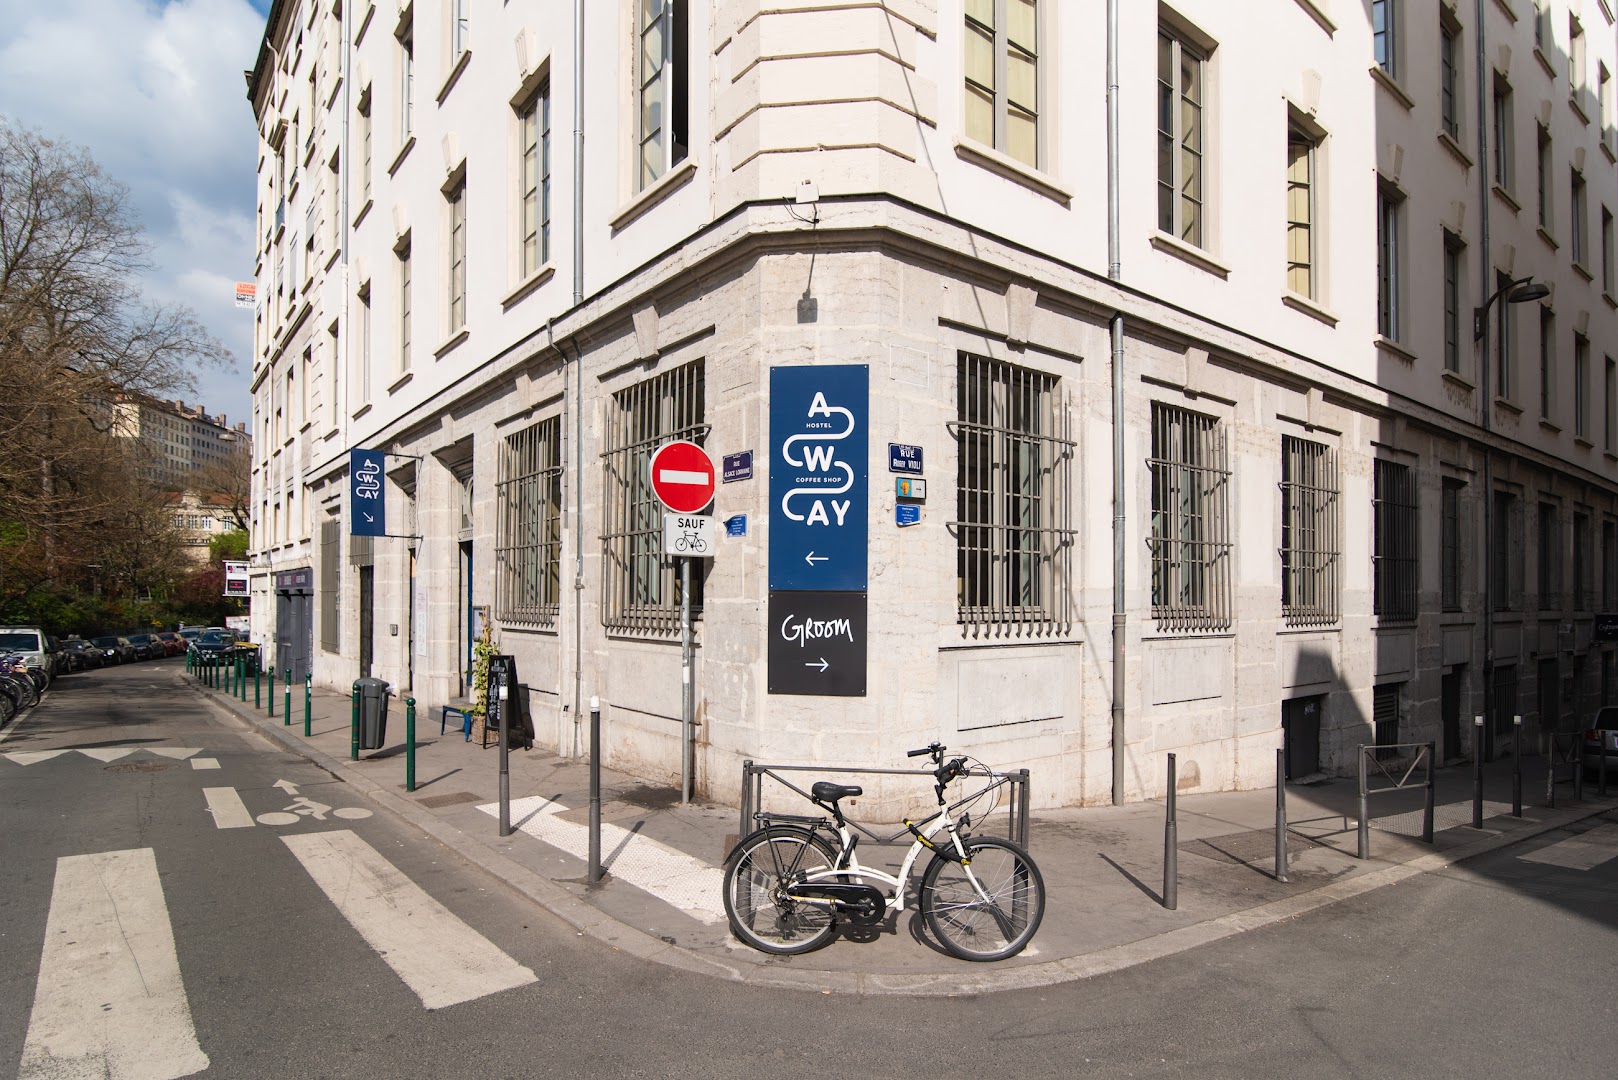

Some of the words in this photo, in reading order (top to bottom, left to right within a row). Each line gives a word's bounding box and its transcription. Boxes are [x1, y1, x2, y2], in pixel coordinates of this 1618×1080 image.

[900, 450, 915, 458] RUE
[908, 460, 920, 470] VIOLI
[724, 470, 736, 478] ALSACE
[736, 467, 750, 476] LORRAINE
[678, 518, 705, 529] SAUF
